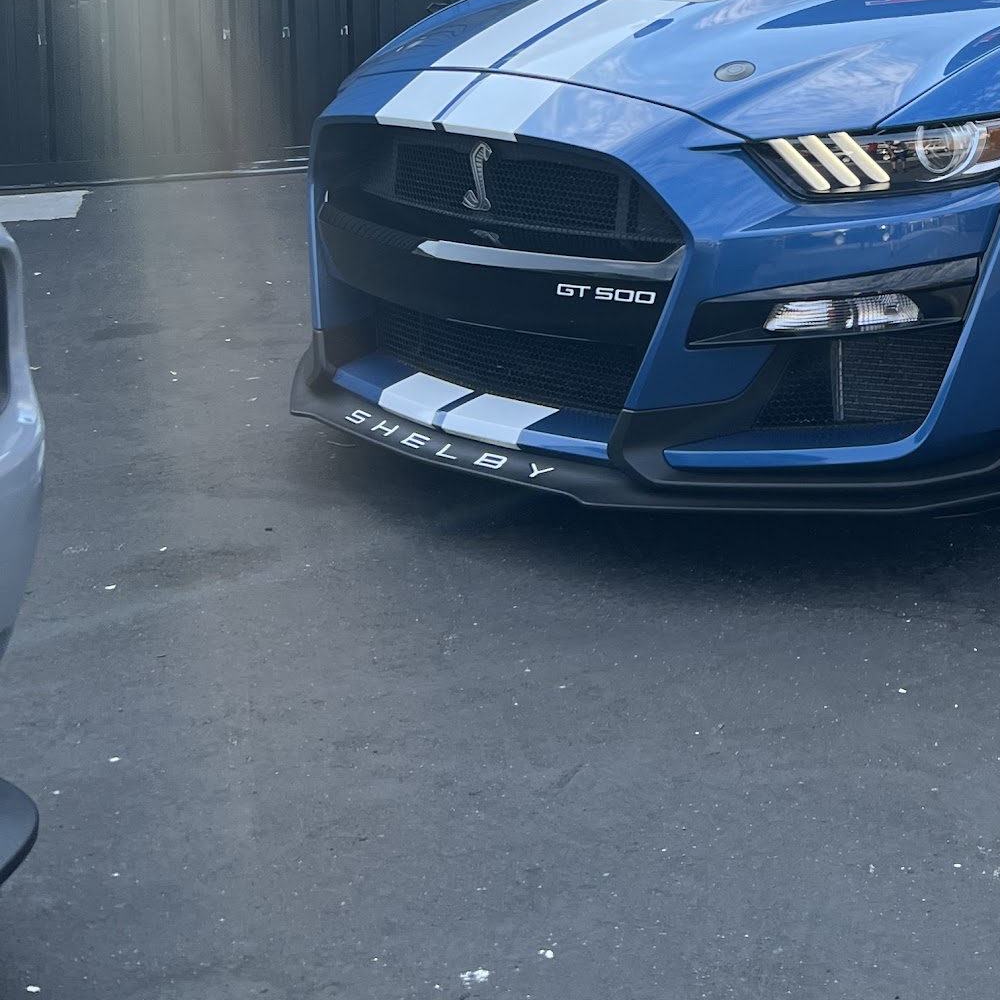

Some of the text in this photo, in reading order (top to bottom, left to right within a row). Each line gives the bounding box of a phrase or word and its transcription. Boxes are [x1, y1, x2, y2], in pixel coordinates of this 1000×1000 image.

[556, 283, 657, 305] GT 500
[345, 409, 555, 478] SHELBY
